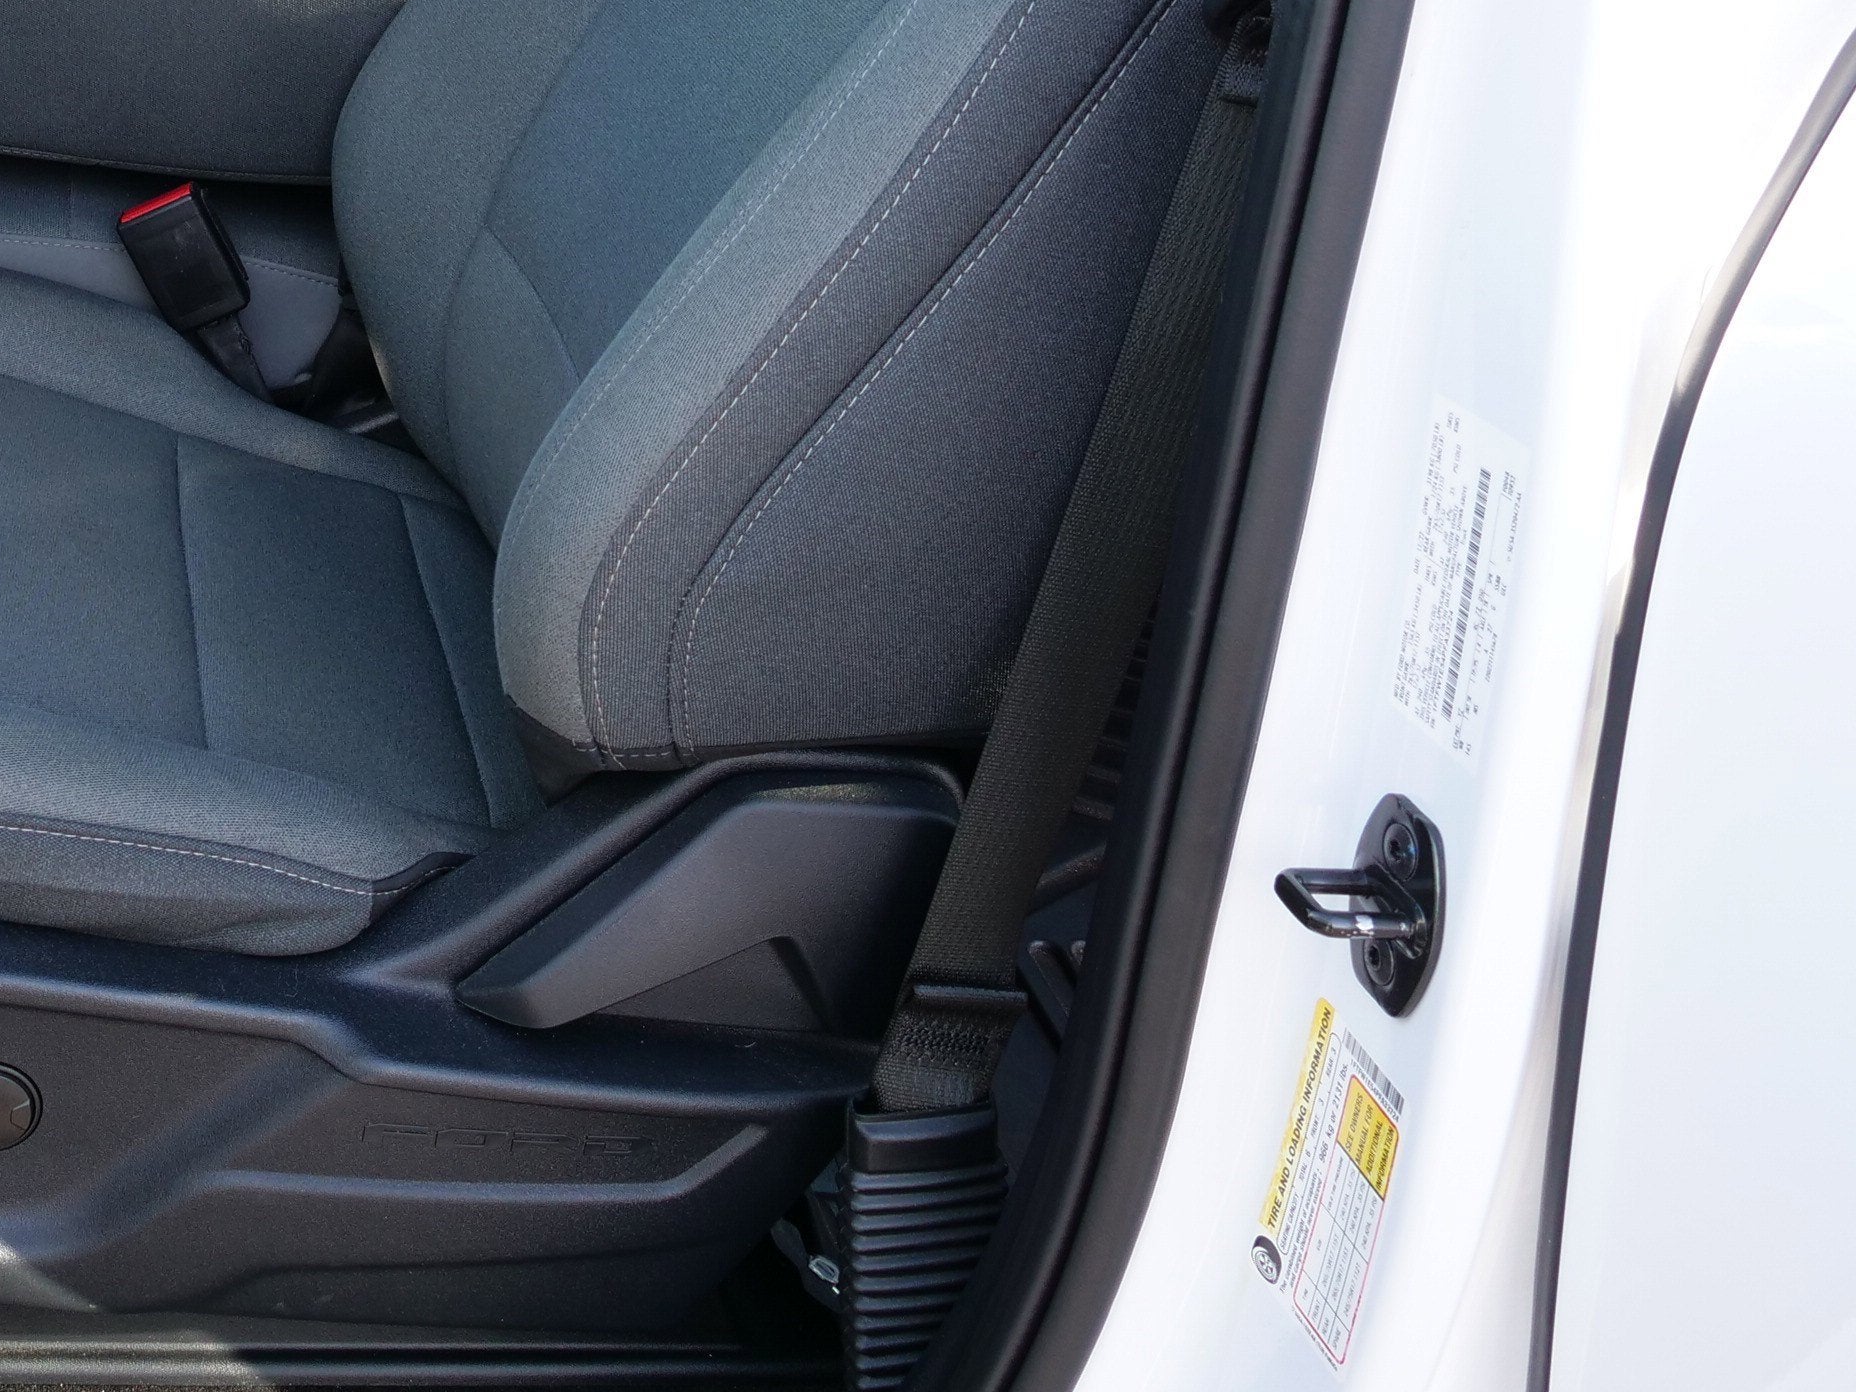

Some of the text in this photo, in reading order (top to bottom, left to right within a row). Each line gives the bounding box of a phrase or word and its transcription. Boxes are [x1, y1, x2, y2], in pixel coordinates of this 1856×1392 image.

[1266, 1005, 1332, 1227] TIRE AND LOADING INFORMATION
[1318, 1063, 1348, 1163] 966 kg or 2131 lbs.
[1344, 1130, 1354, 1152] SEE
[1354, 1103, 1374, 1164] MANUAL FOR
[1364, 1118, 1383, 1173] ADDITIONAL
[1375, 1125, 1394, 1190] INFORMATION
